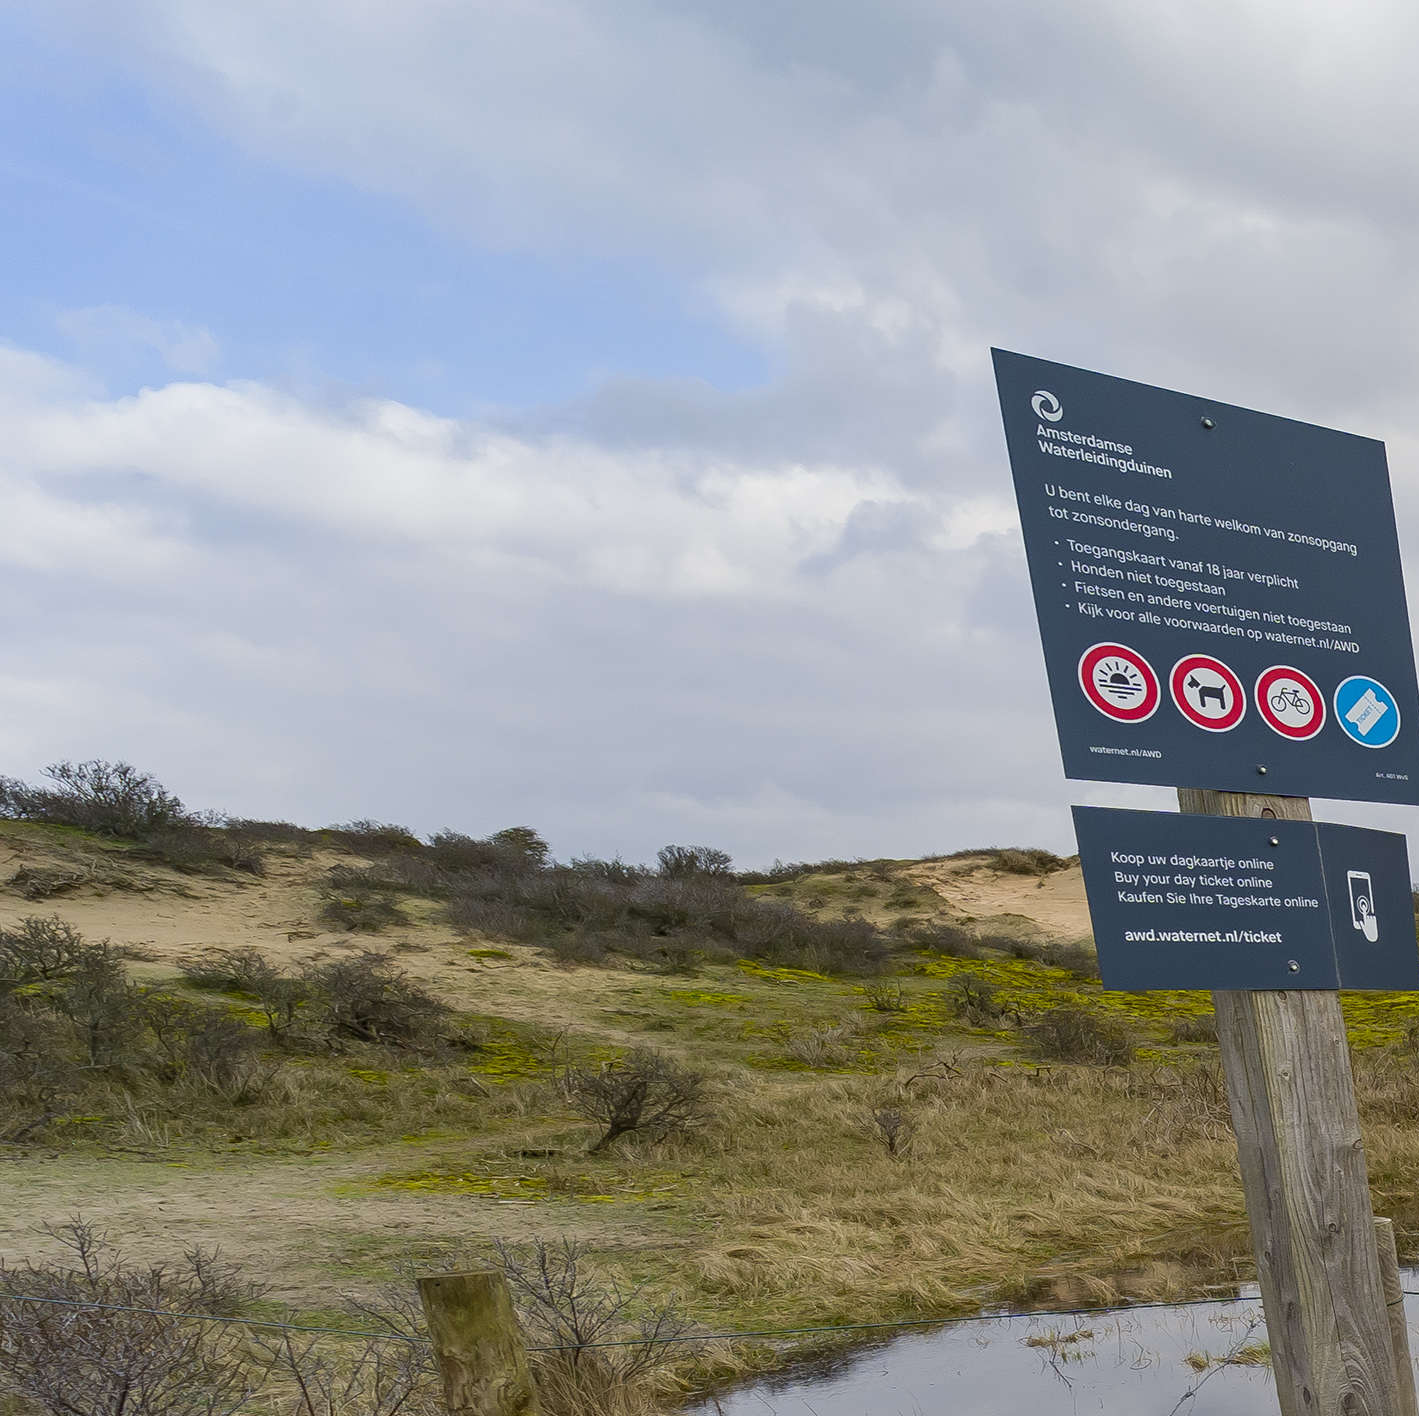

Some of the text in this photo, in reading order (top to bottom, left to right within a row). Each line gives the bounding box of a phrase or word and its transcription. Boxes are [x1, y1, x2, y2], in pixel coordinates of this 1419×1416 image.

[1036, 423, 1133, 456] Amsterdamse
[1037, 439, 1173, 480] Waterleidingduinen
[1044, 483, 1358, 557] U bent elke dag van harte welkom van zonsopgang
[1048, 505, 1180, 542] tot zonsondergang.
[1066, 538, 1300, 590] Toegangskaart vanaf 18 jaar verplicht
[1070, 559, 1226, 596] Honden niet toegestaan
[1074, 580, 1352, 635] Fietsen en andere voertuigen niet toegestaan
[1077, 601, 1360, 654] Kijk voor alle voorwaarden op waternet.nl/AWD
[1356, 705, 1374, 725] TICKET
[1089, 744, 1163, 760] waternet.nl/AWD
[1110, 851, 1275, 871] Koop uw dagkaartje online
[1114, 871, 1273, 890] Buy your day ticket online
[1117, 890, 1319, 909] Kaufen Sie Ihre Tageskarte online
[1124, 928, 1283, 944] awd.waternet.nl/ticket
